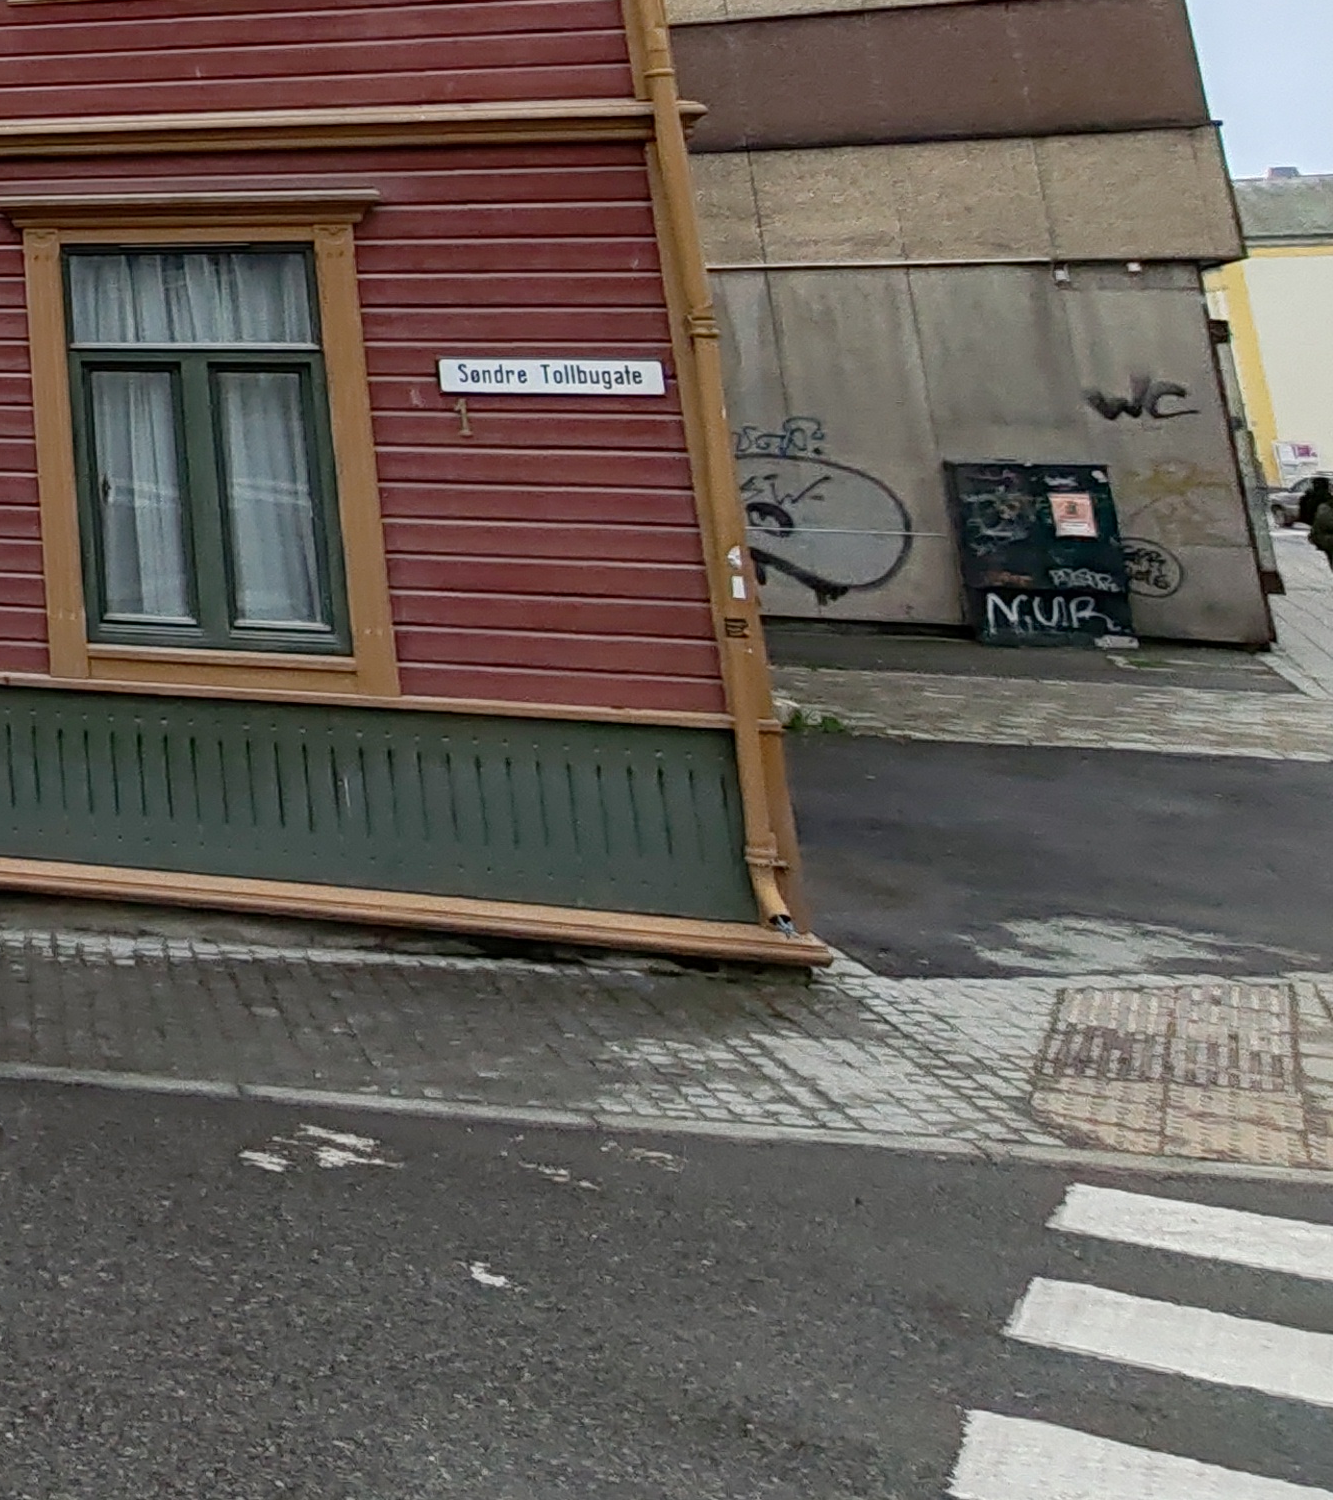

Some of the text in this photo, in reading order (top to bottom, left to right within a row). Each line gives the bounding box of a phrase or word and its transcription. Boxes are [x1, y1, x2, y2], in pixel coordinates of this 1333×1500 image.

[458, 363, 643, 390] Søndre Tollbugate
[454, 397, 473, 436] 1
